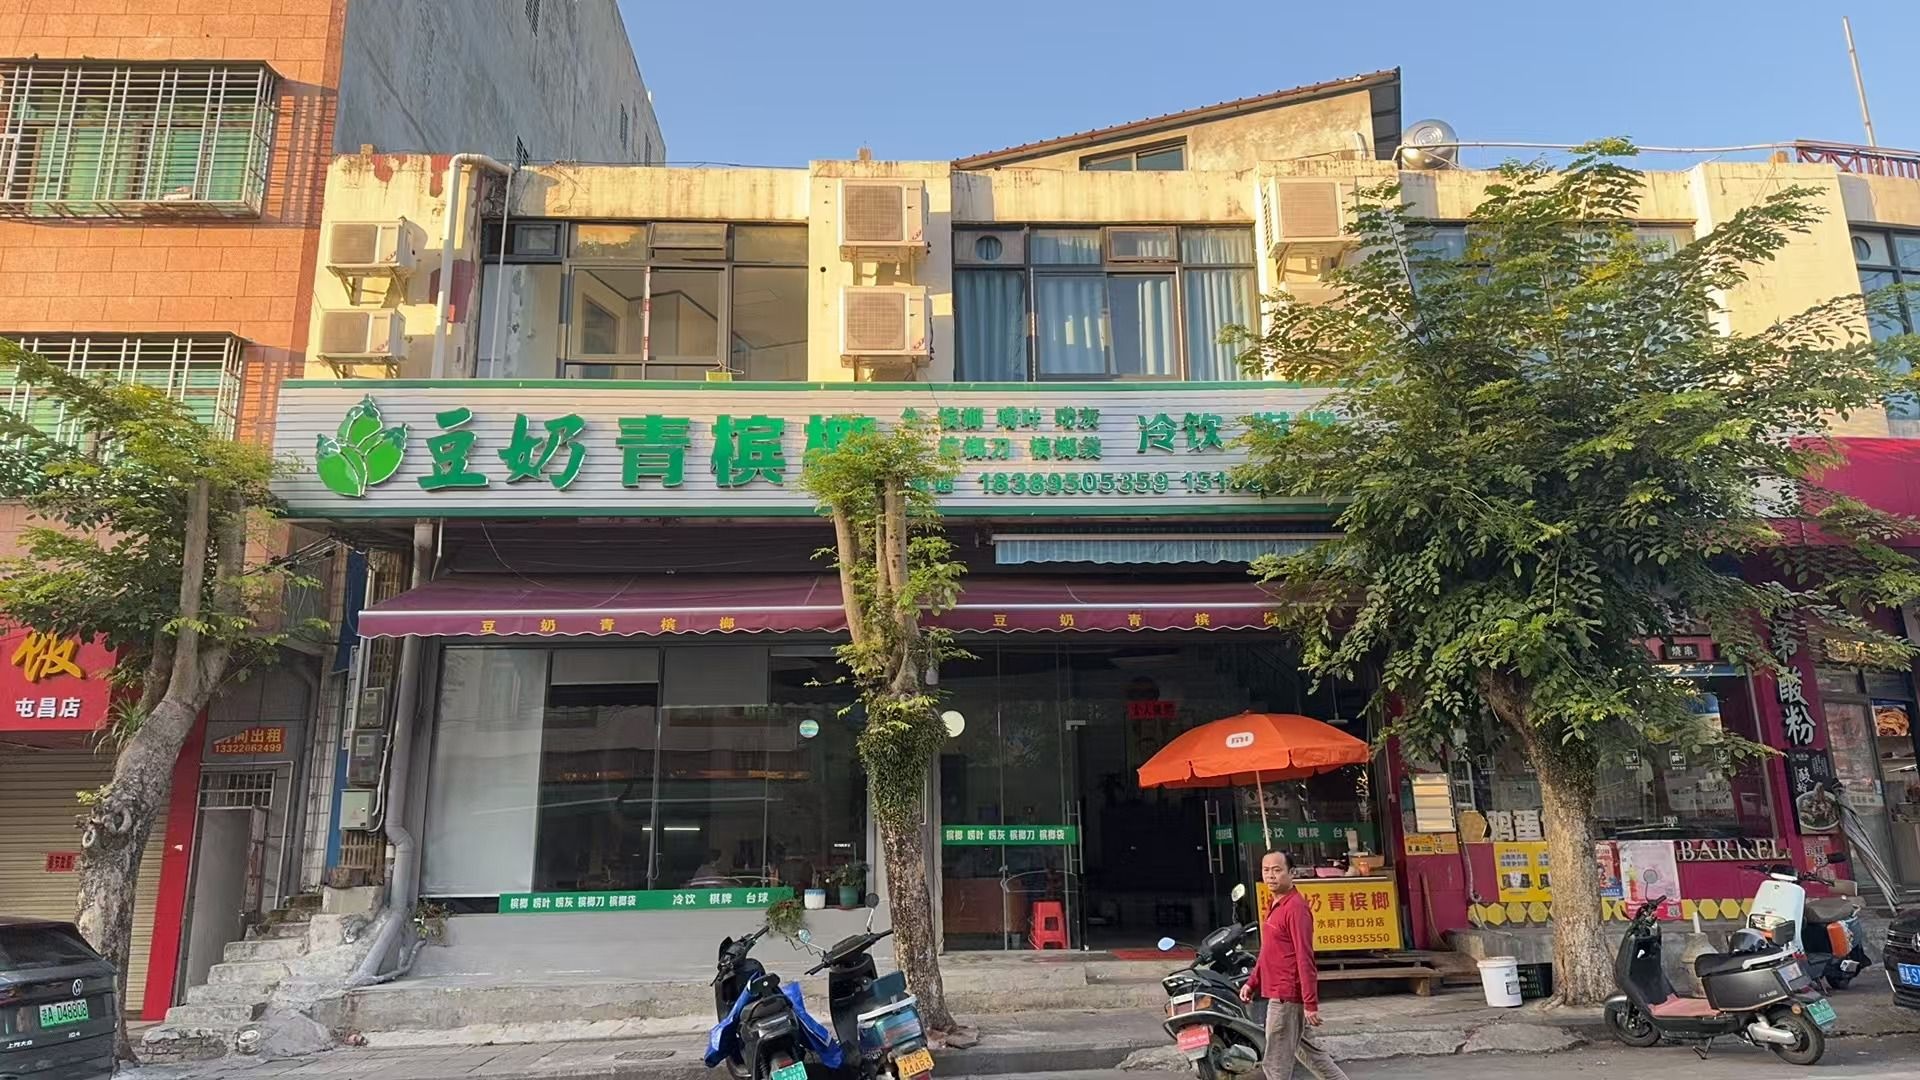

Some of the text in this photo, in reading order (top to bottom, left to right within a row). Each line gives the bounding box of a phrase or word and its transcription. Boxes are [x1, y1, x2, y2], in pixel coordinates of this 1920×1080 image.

[1137, 413, 1226, 454] 冷饮
[977, 472, 1168, 495] 18389505359
[15, 697, 81, 718] 屯昌店
[672, 893, 696, 905] 冷饮
[709, 893, 733, 904] 棋牌
[746, 892, 769, 904] 台球
[1317, 933, 1390, 944] 18689935550
